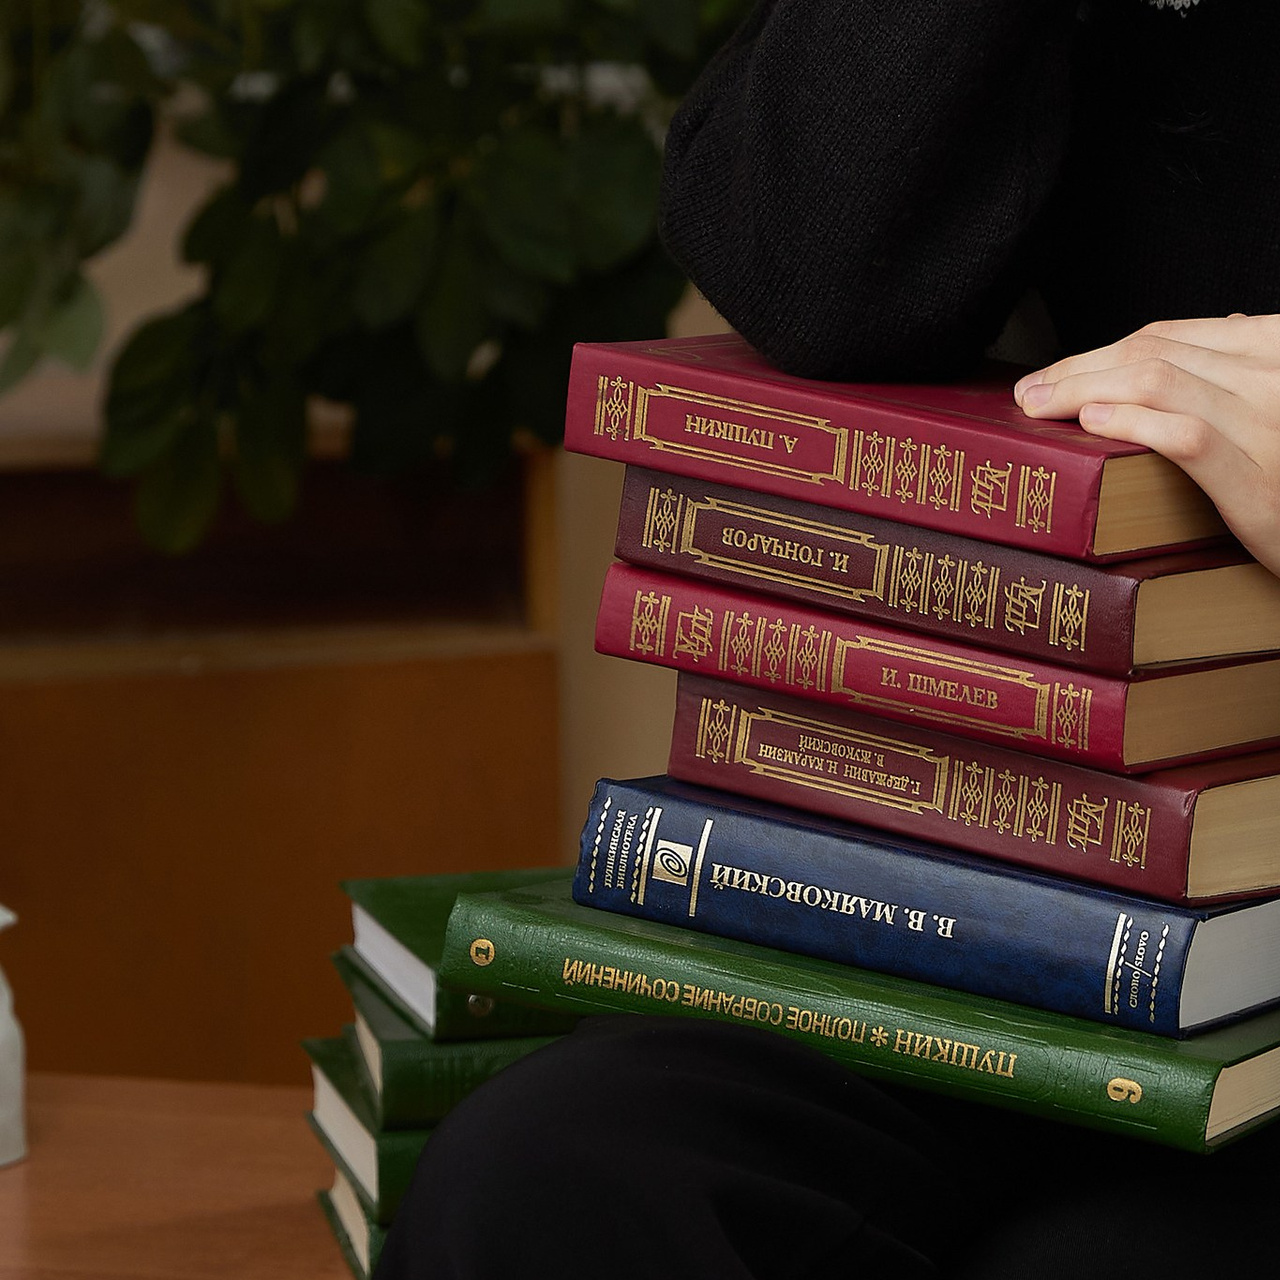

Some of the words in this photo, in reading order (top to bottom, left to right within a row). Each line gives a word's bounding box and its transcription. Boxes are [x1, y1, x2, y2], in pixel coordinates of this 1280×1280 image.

[684, 414, 774, 451] ПУШКИН
[778, 433, 799, 454] А.
[721, 526, 823, 567] ГОНЧАРОВ
[829, 551, 849, 573] И.
[880, 666, 902, 689] И.
[907, 672, 999, 710] ШМЕЛЕВ
[758, 743, 826, 772] КАРАМЗИН
[799, 733, 871, 765] ЖУКОВСКИЙ
[872, 752, 885, 768] В.
[604, 809, 627, 888] ПУШКИНСКАЯ
[616, 814, 639, 889] БИБЛИОТЕКА
[709, 862, 899, 926] МАЯКОВСКИЙ
[903, 907, 927, 932] В.
[931, 913, 957, 938] В.
[561, 957, 681, 1003] СОЧИНЕНИЙ
[681, 983, 783, 1026] СОБРАНИЕ
[785, 1006, 867, 1044] ПОЛНОЕ
[892, 1028, 1018, 1078] ПУШКИН
